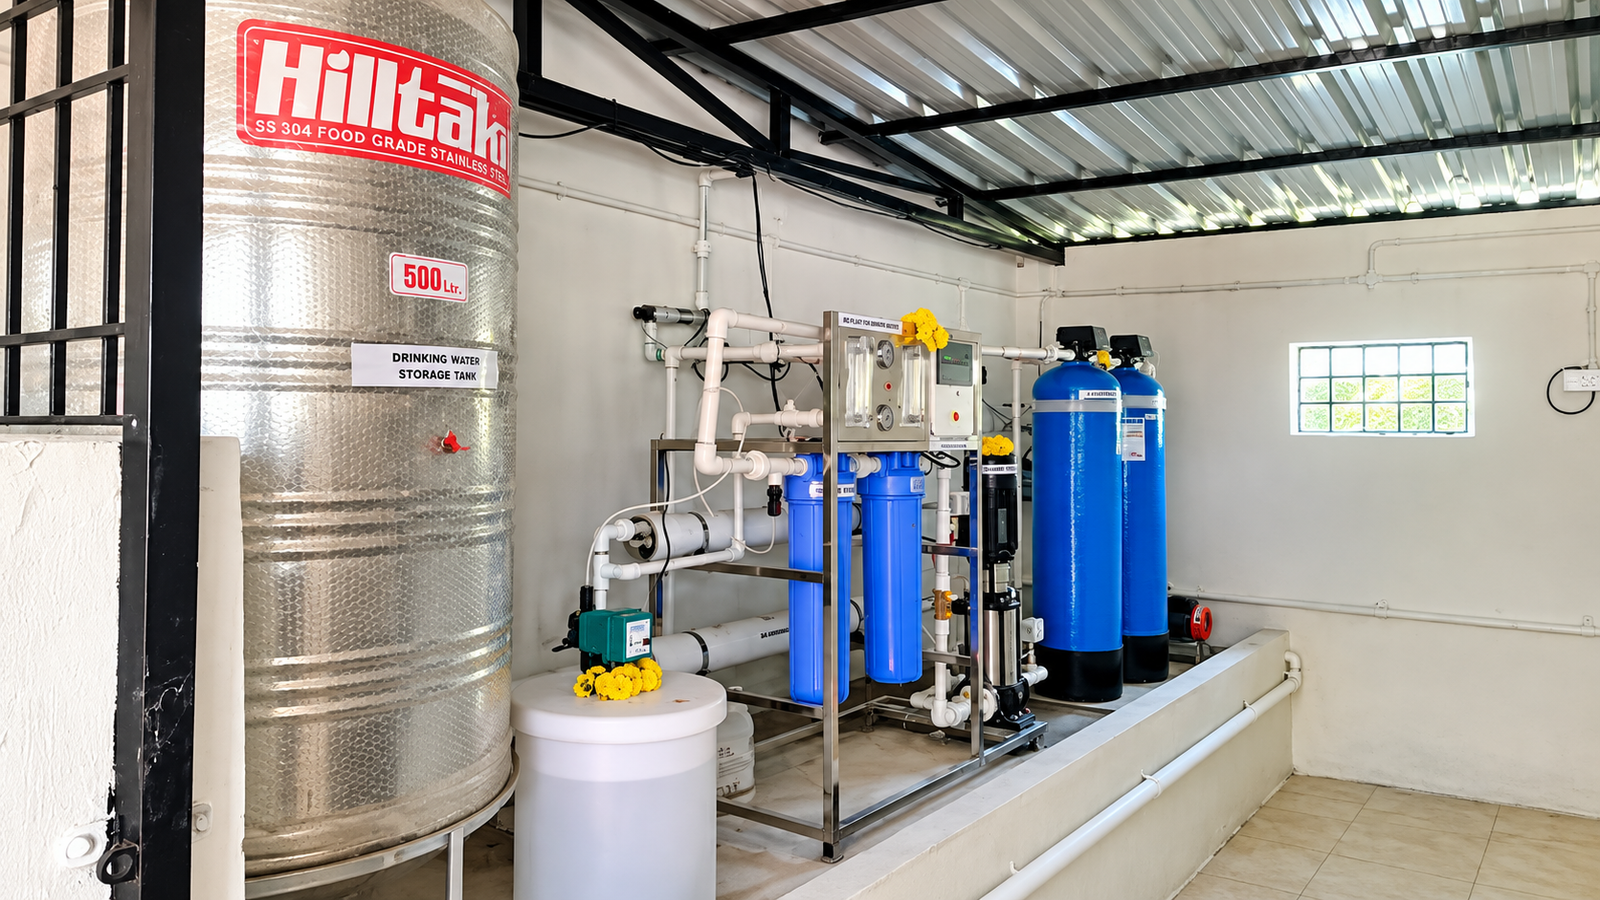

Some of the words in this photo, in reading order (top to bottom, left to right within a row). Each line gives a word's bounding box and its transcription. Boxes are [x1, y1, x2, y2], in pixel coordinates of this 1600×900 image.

[255, 119, 276, 133] SS
[281, 122, 312, 137] 304
[317, 126, 366, 143] FOOD
[371, 133, 427, 156] GRADE
[430, 146, 488, 175] STAINLESS
[404, 263, 442, 291] 500
[443, 279, 462, 294] Ltr.
[392, 352, 447, 364] DRINKING
[451, 355, 480, 365] WATER
[398, 369, 451, 380] STORAGE
[454, 371, 477, 381] TANK
